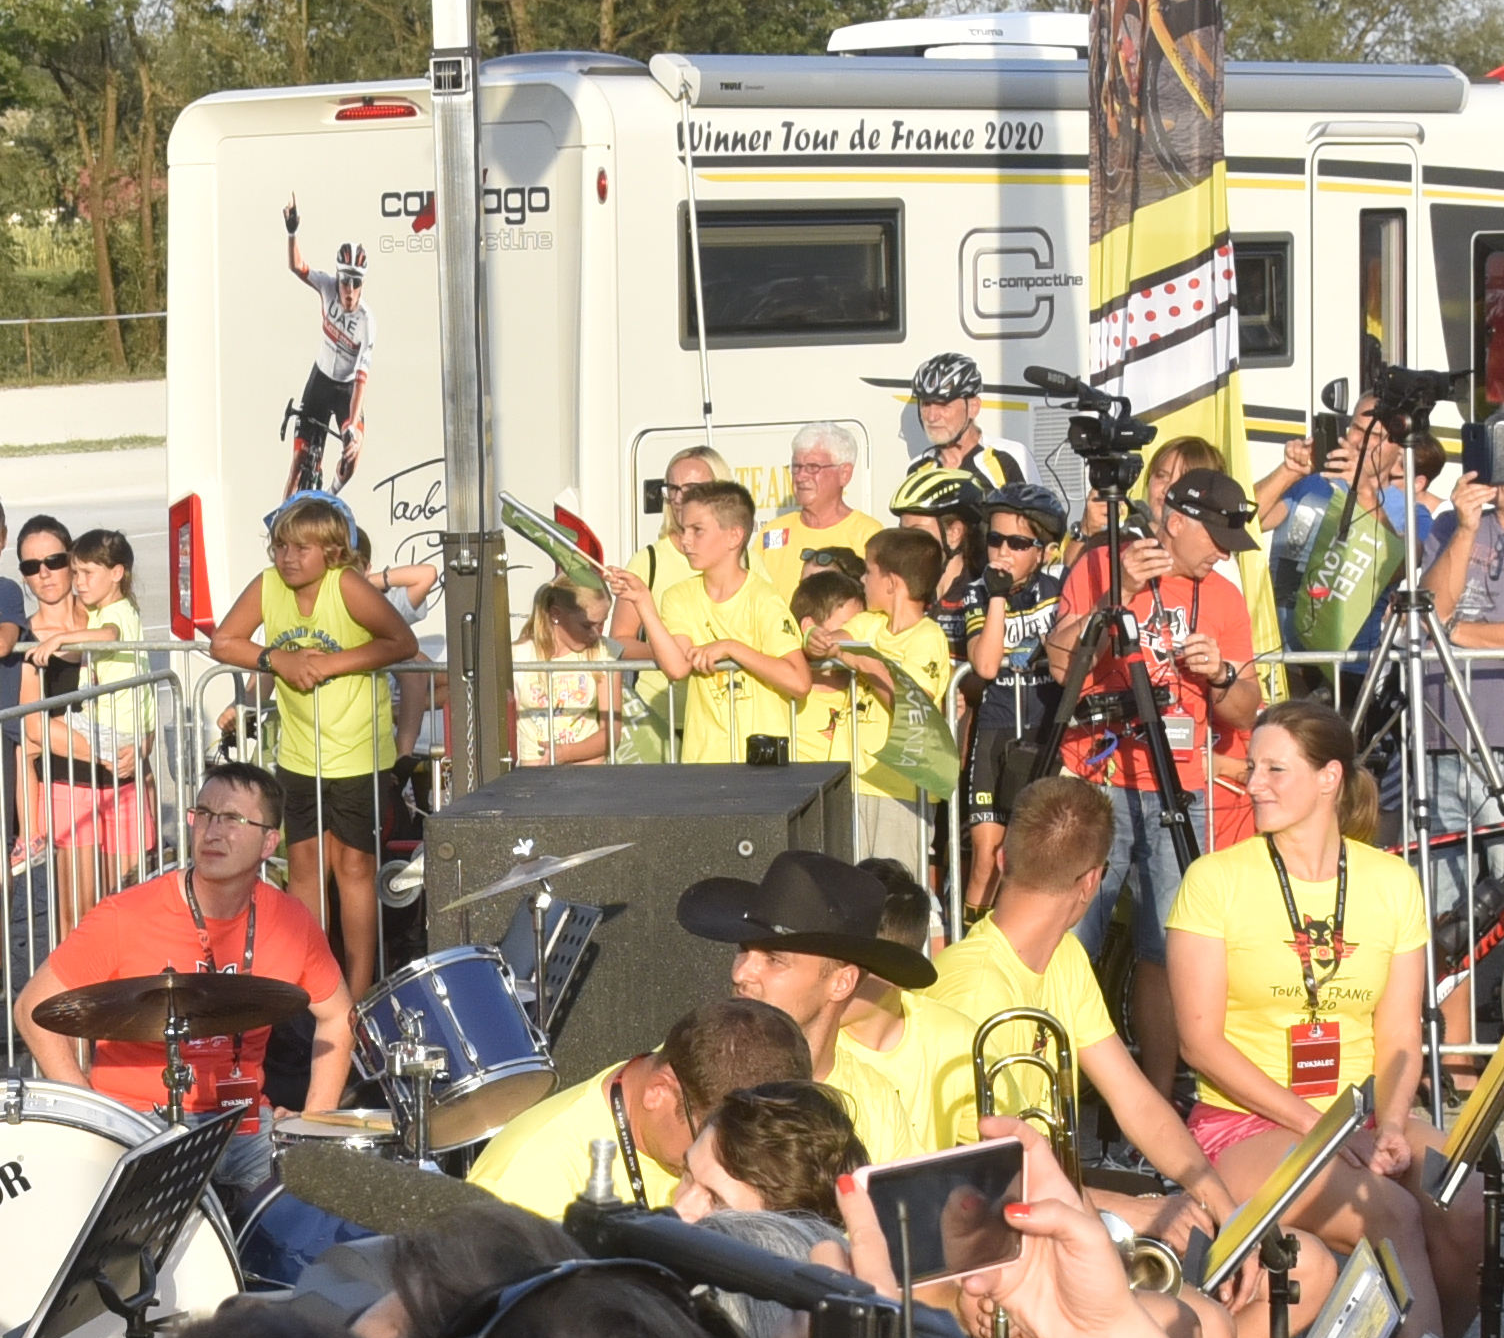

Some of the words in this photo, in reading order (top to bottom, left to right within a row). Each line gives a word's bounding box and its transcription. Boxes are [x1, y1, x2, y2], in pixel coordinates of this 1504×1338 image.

[677, 120, 772, 152] Winner
[781, 121, 840, 153] Tour
[850, 118, 880, 151] de
[891, 120, 975, 151] France
[985, 121, 1045, 151] 2020
[982, 272, 1084, 293] c-compactline
[1327, 547, 1373, 603] FEEL
[1269, 985, 1305, 1000] TOUR
[1327, 986, 1374, 1003] FRANCE
